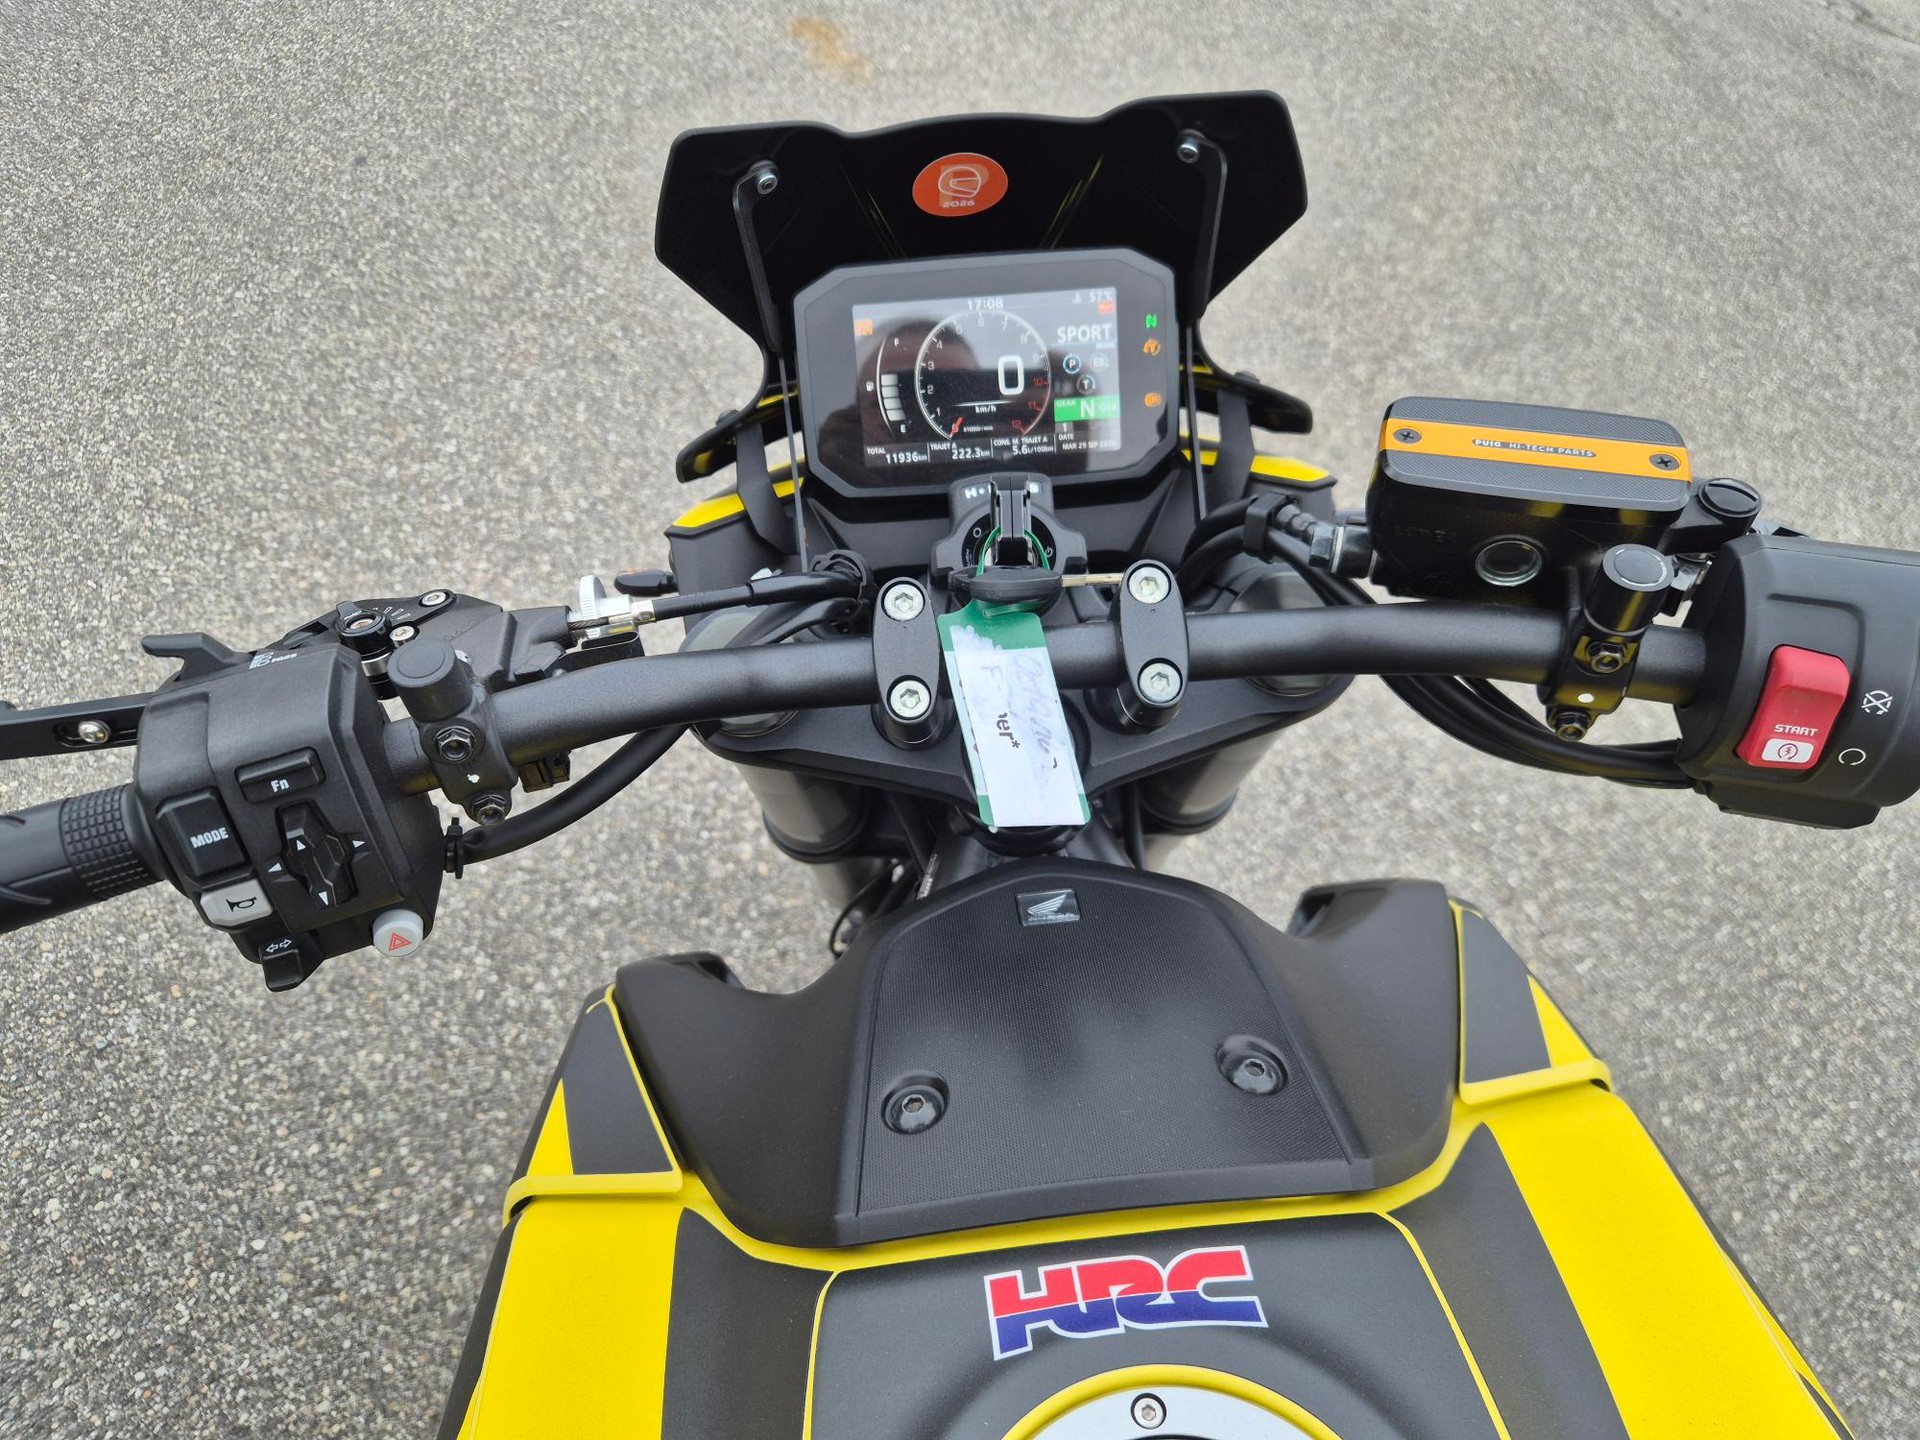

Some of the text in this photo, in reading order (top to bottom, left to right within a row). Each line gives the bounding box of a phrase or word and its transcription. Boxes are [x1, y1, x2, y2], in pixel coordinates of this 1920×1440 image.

[942, 200, 976, 208] 2026
[968, 298, 1003, 311] 17:08
[1057, 324, 1112, 343] SPORT
[936, 340, 943, 350] 4
[928, 361, 935, 370] 3
[1069, 360, 1076, 368] P
[998, 355, 1024, 395] 0
[1082, 380, 1089, 389] T
[927, 385, 934, 394] 2
[975, 405, 996, 413] km/h
[1080, 400, 1095, 417] N
[1021, 436, 1041, 444] TRAJET
[930, 443, 951, 451] TRAJET
[1062, 442, 1077, 450] MAR
[1475, 439, 1594, 457] PUIG HI-TECH PARTS
[867, 447, 886, 455] TOTAL
[1774, 724, 1818, 737] START
[270, 779, 290, 793] Fn
[190, 827, 229, 848] MODE
[984, 1245, 1268, 1361] HRC
